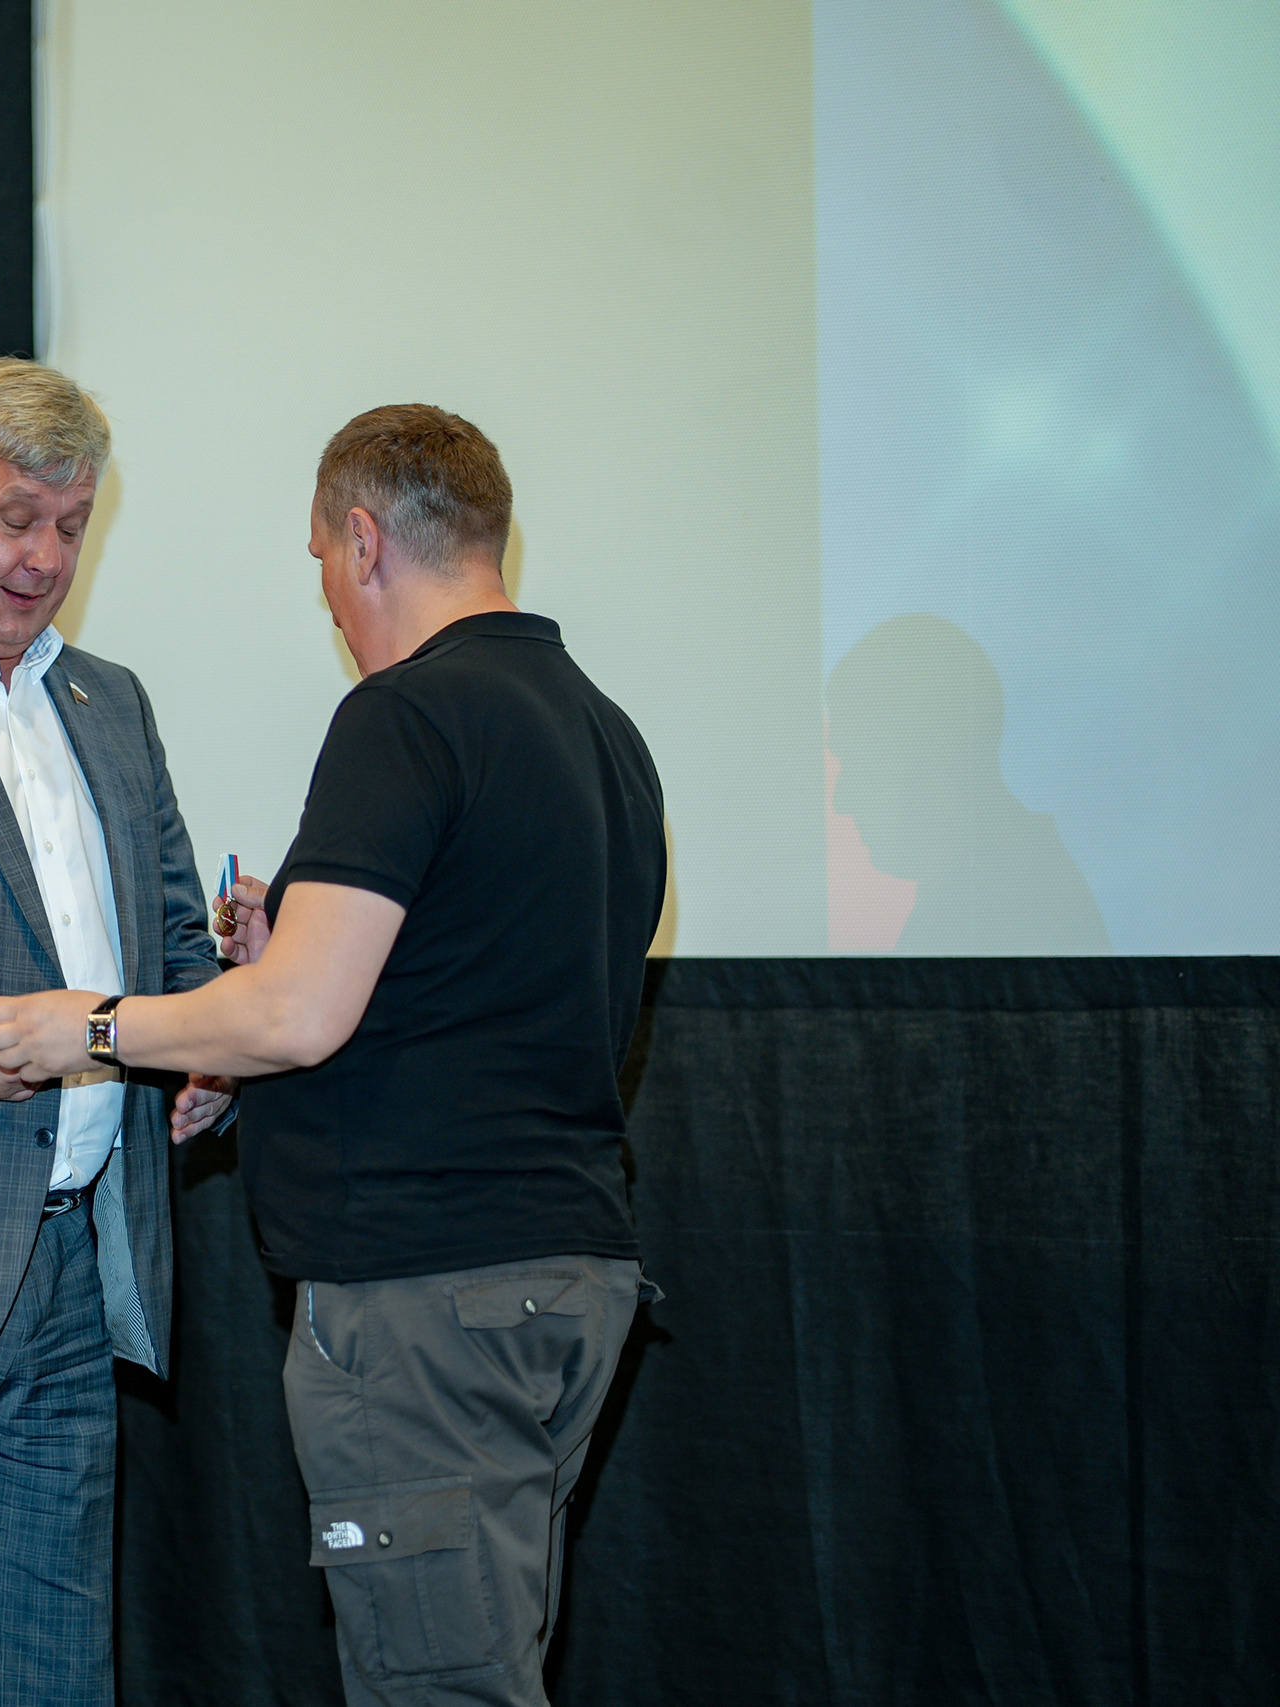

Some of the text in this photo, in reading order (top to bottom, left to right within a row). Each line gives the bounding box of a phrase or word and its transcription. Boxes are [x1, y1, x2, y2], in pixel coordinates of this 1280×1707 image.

[330, 1521, 347, 1532] THE
[322, 1530, 348, 1542] NORTH
[328, 1539, 348, 1550] FACE
